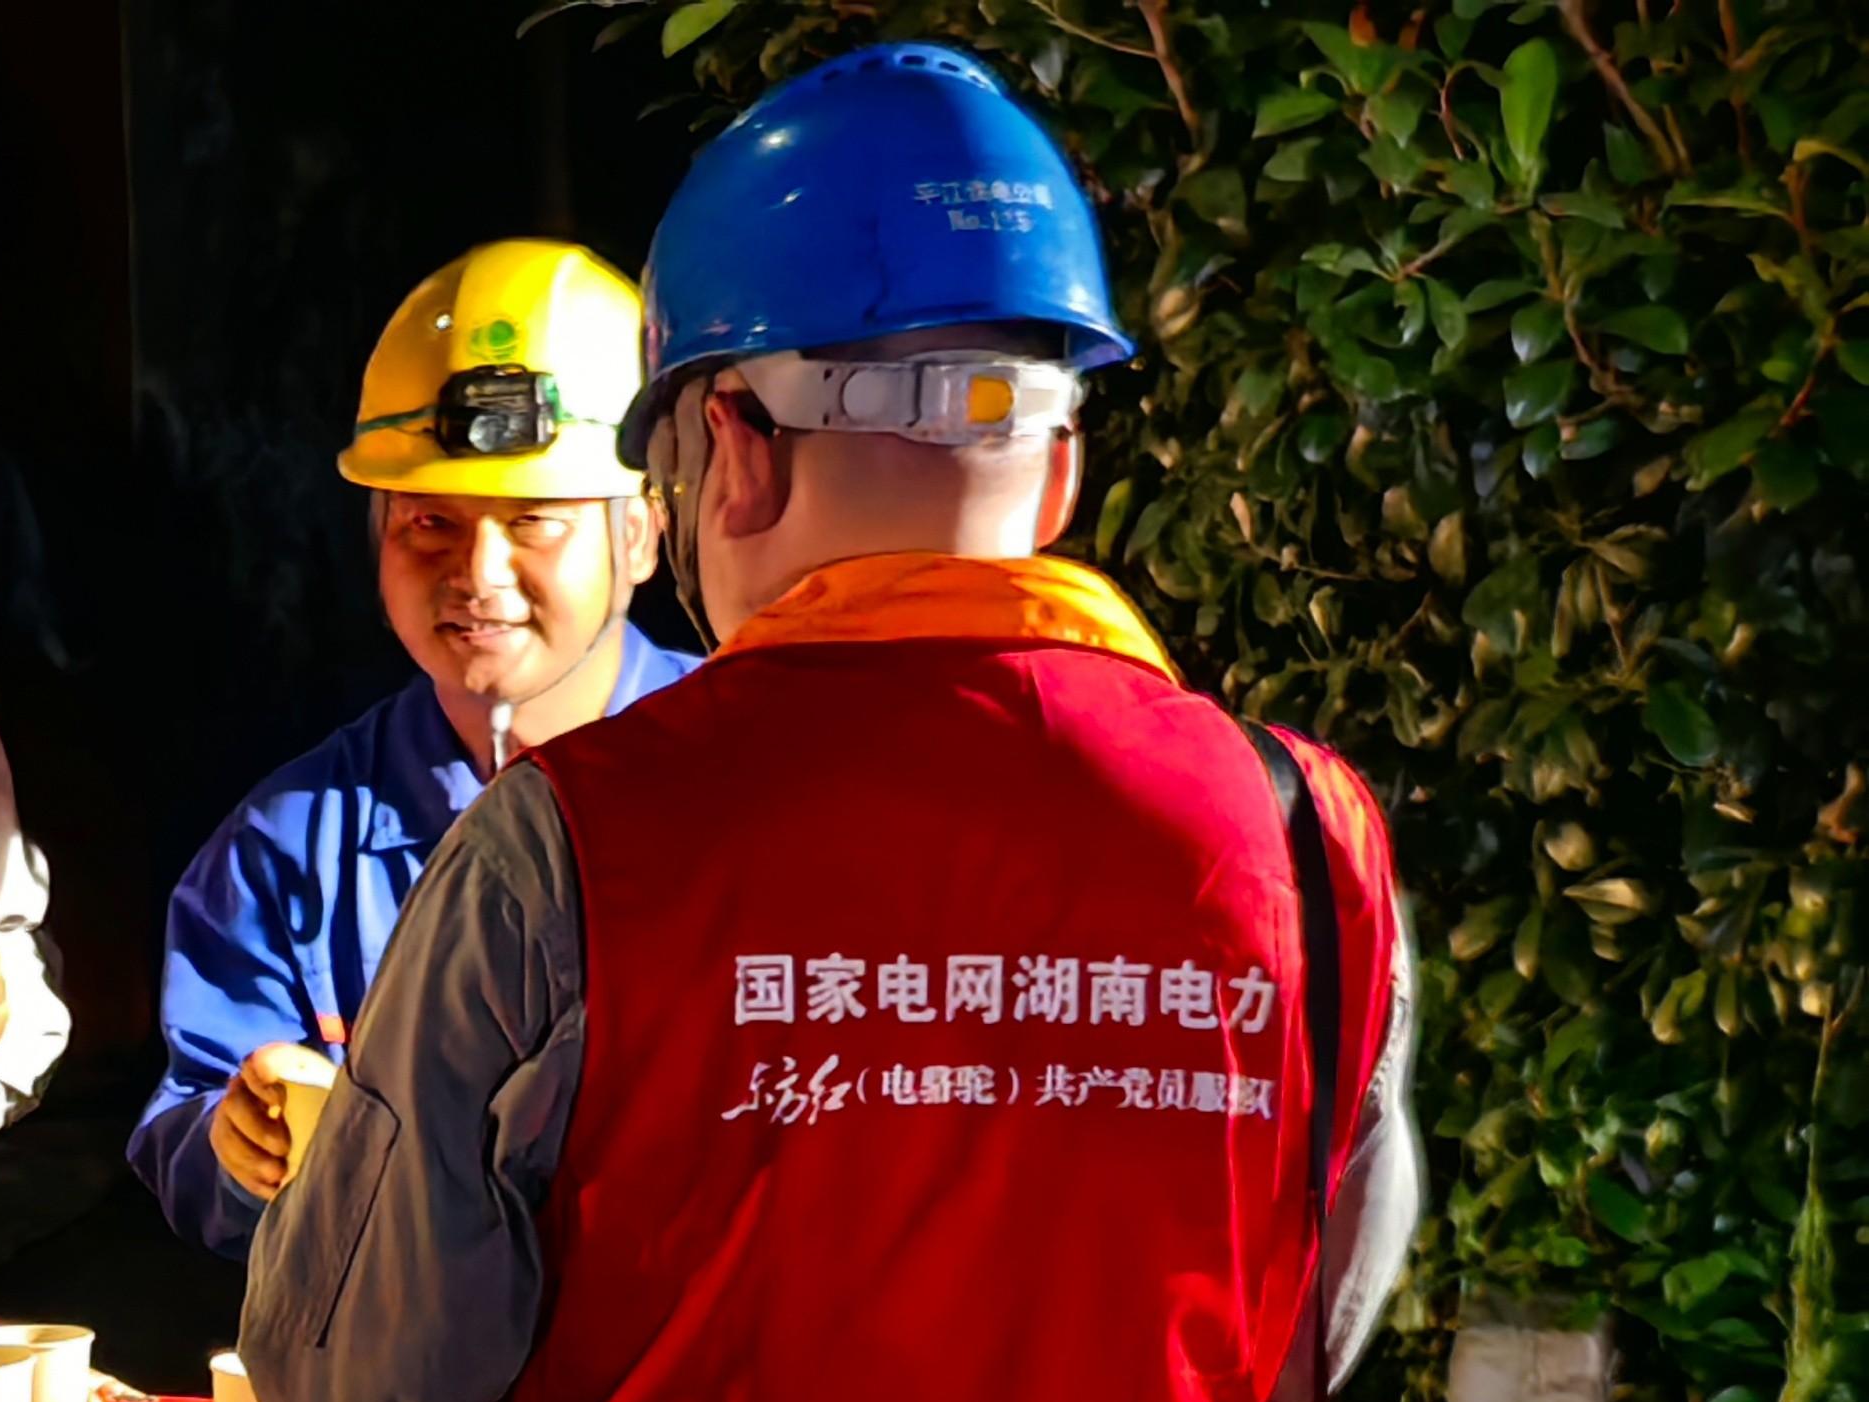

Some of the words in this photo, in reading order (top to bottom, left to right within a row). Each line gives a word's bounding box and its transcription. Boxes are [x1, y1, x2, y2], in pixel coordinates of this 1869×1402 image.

[734, 953, 1275, 1033] 国家电网湖南电力
